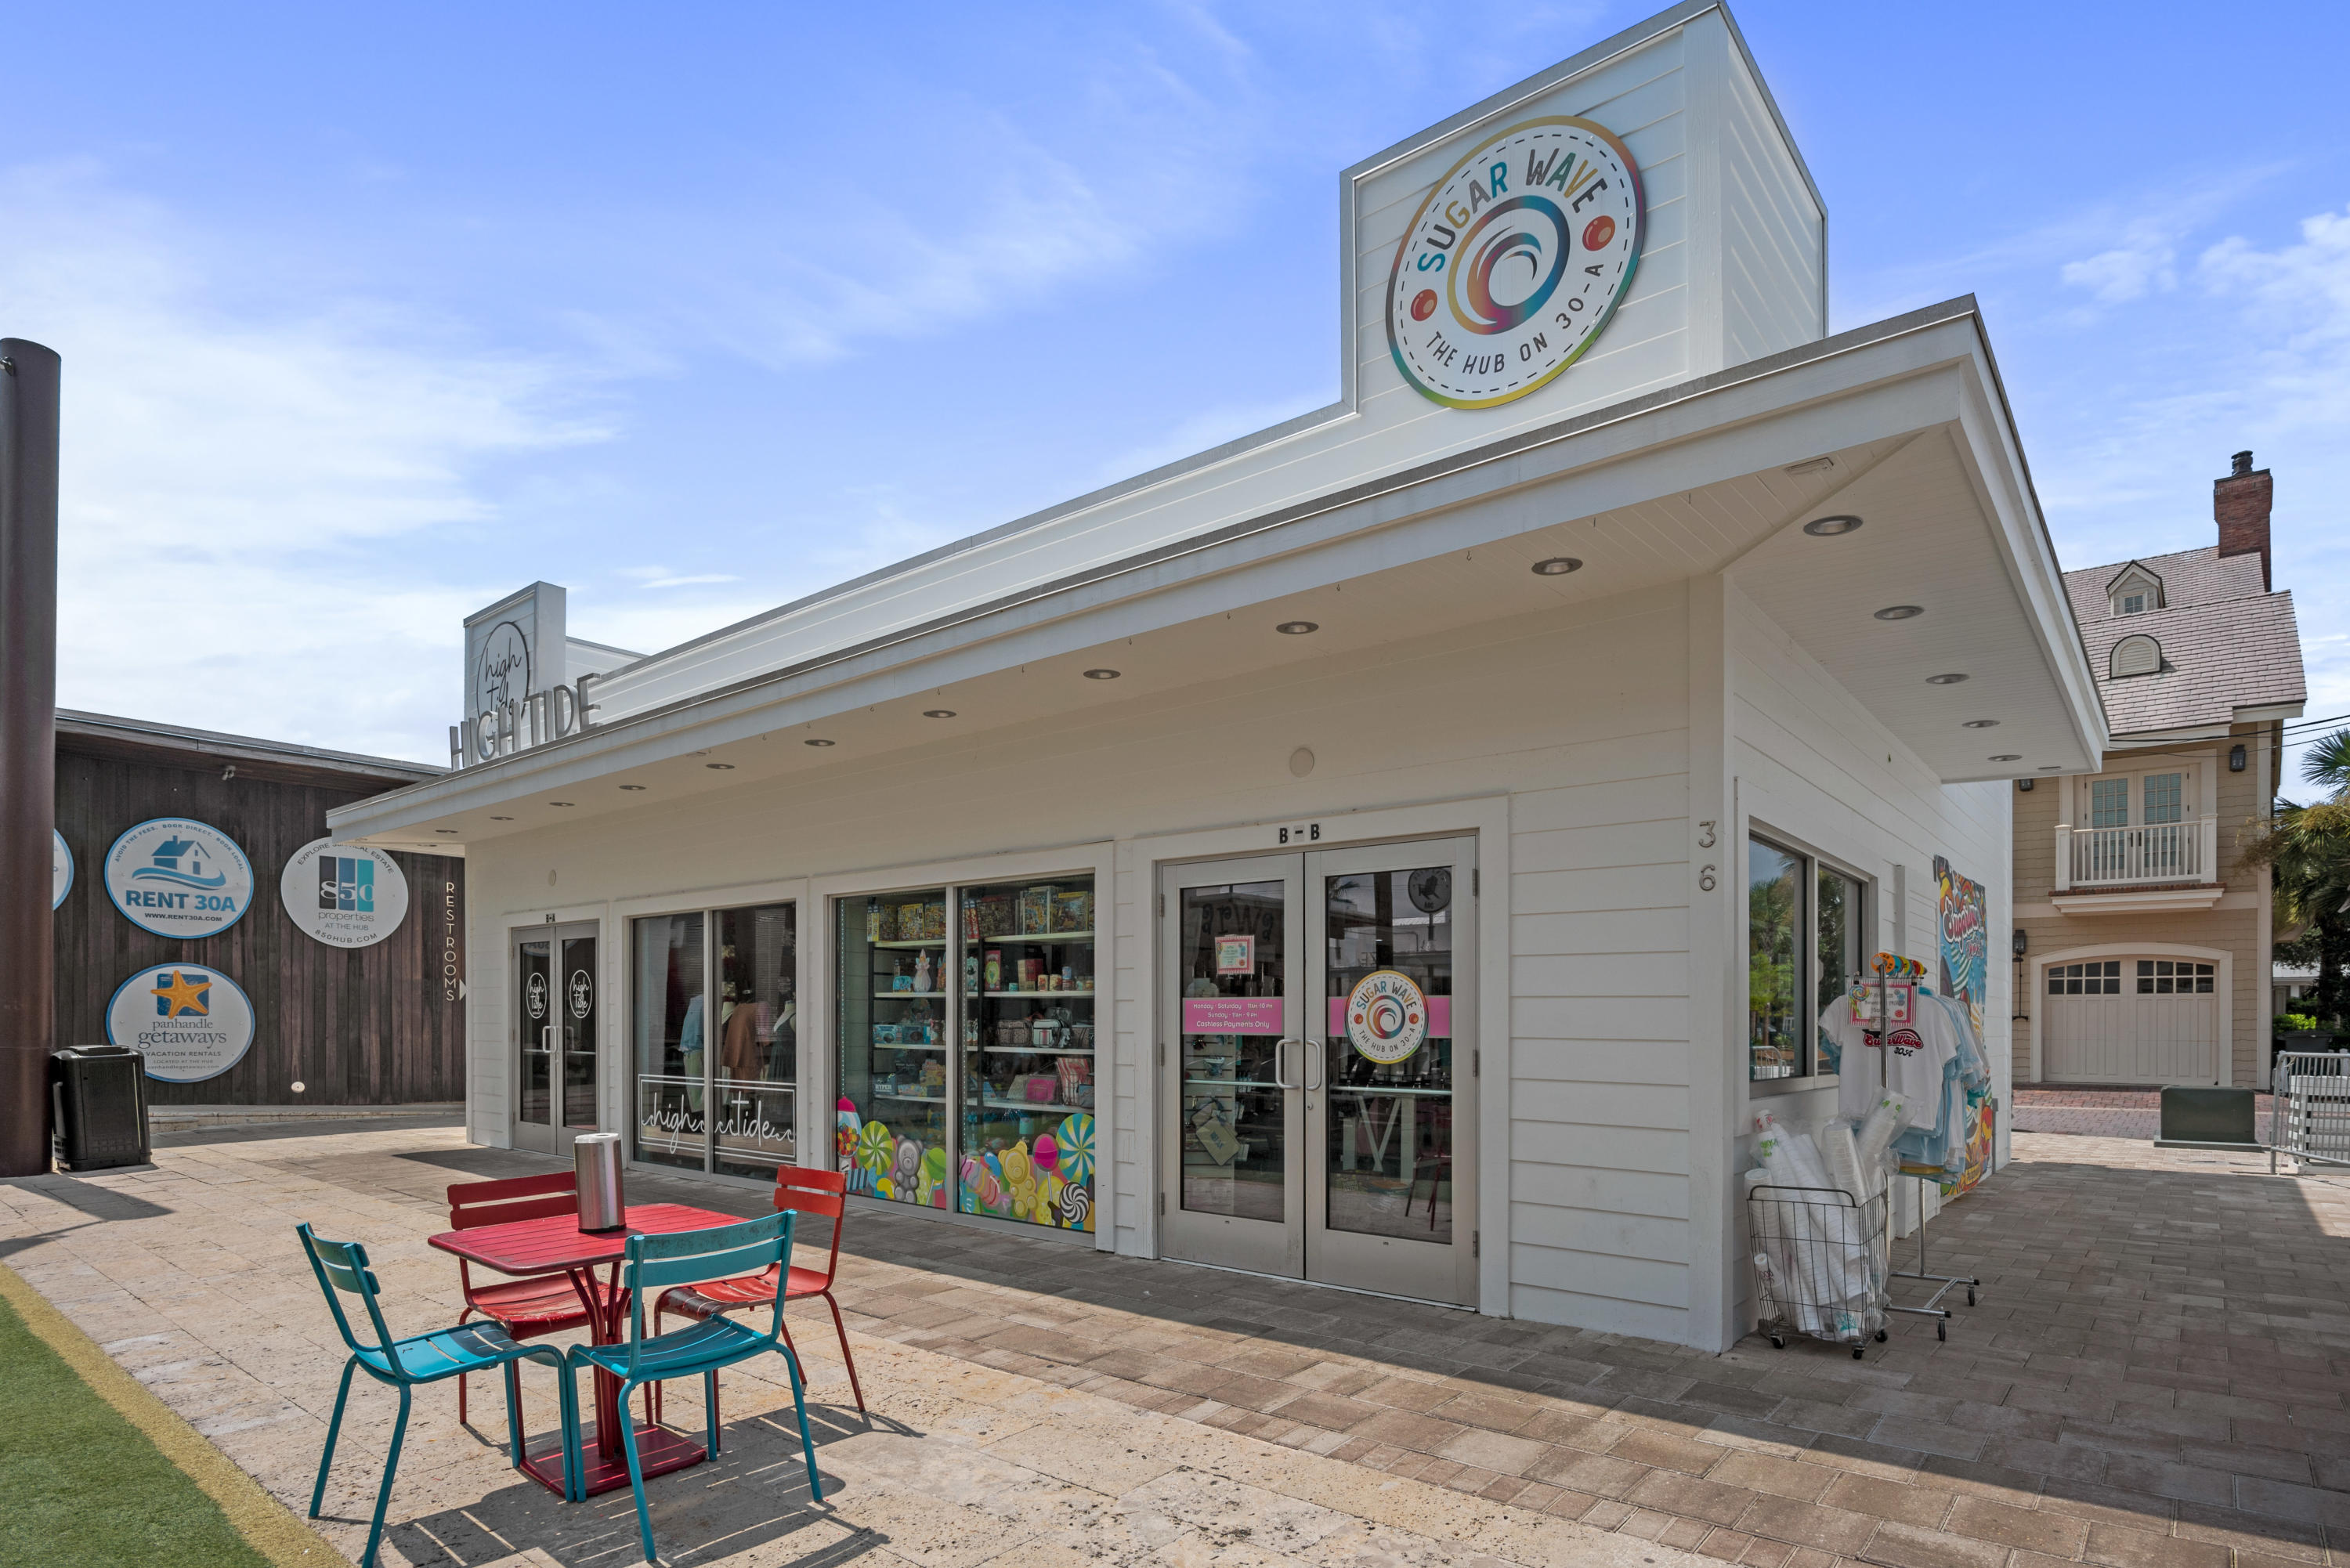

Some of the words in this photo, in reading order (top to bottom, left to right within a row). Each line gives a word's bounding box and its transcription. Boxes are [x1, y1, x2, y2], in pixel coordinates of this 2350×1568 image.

[1417, 161, 1509, 274] SUGAR
[1526, 148, 1608, 214] WAVE
[1426, 331, 1459, 368] THE
[1462, 353, 1506, 375] HUB
[1520, 332, 1548, 362] ON
[1556, 263, 1604, 330] 30-A
[485, 638, 522, 703] high
[450, 702, 521, 771] HIGH
[522, 673, 602, 746] TIDE
[115, 845, 127, 862] AVOID
[126, 834, 138, 845] THE
[139, 826, 157, 836] FEES.
[186, 825, 213, 837] DIRECT.
[215, 837, 232, 852] BOOK
[231, 851, 244, 873] LOCAL.
[297, 843, 330, 865] EXPLORE
[371, 851, 394, 875] ESTATE
[125, 890, 189, 909] RENT
[194, 894, 237, 912] 30A
[320, 880, 374, 901] 850
[144, 912, 222, 922] WWW.RENT30A.COM
[318, 911, 374, 922] properties
[315, 929, 378, 944] 850HUB.COM
[444, 882, 456, 1001] RESTROOMS
[530, 979, 544, 1001] high
[573, 977, 589, 1001] high
[1357, 981, 1386, 1010] SUGAR
[1391, 981, 1417, 1010] WAVE
[530, 993, 544, 1011] tide
[573, 991, 588, 1010] tide
[152, 1018, 213, 1031] panhandle
[1255, 1021, 1270, 1029] Only
[137, 1031, 226, 1049] getaways
[1359, 1028, 1371, 1044] THE
[1371, 1042, 1385, 1052] HUB
[1390, 1043, 1398, 1052] ON
[1401, 1028, 1415, 1046] 30-A
[1863, 1032, 1924, 1050] SuarWave
[1894, 1046, 1914, 1057] 30A
[647, 1092, 699, 1154] high
[731, 1090, 777, 1147] tide
